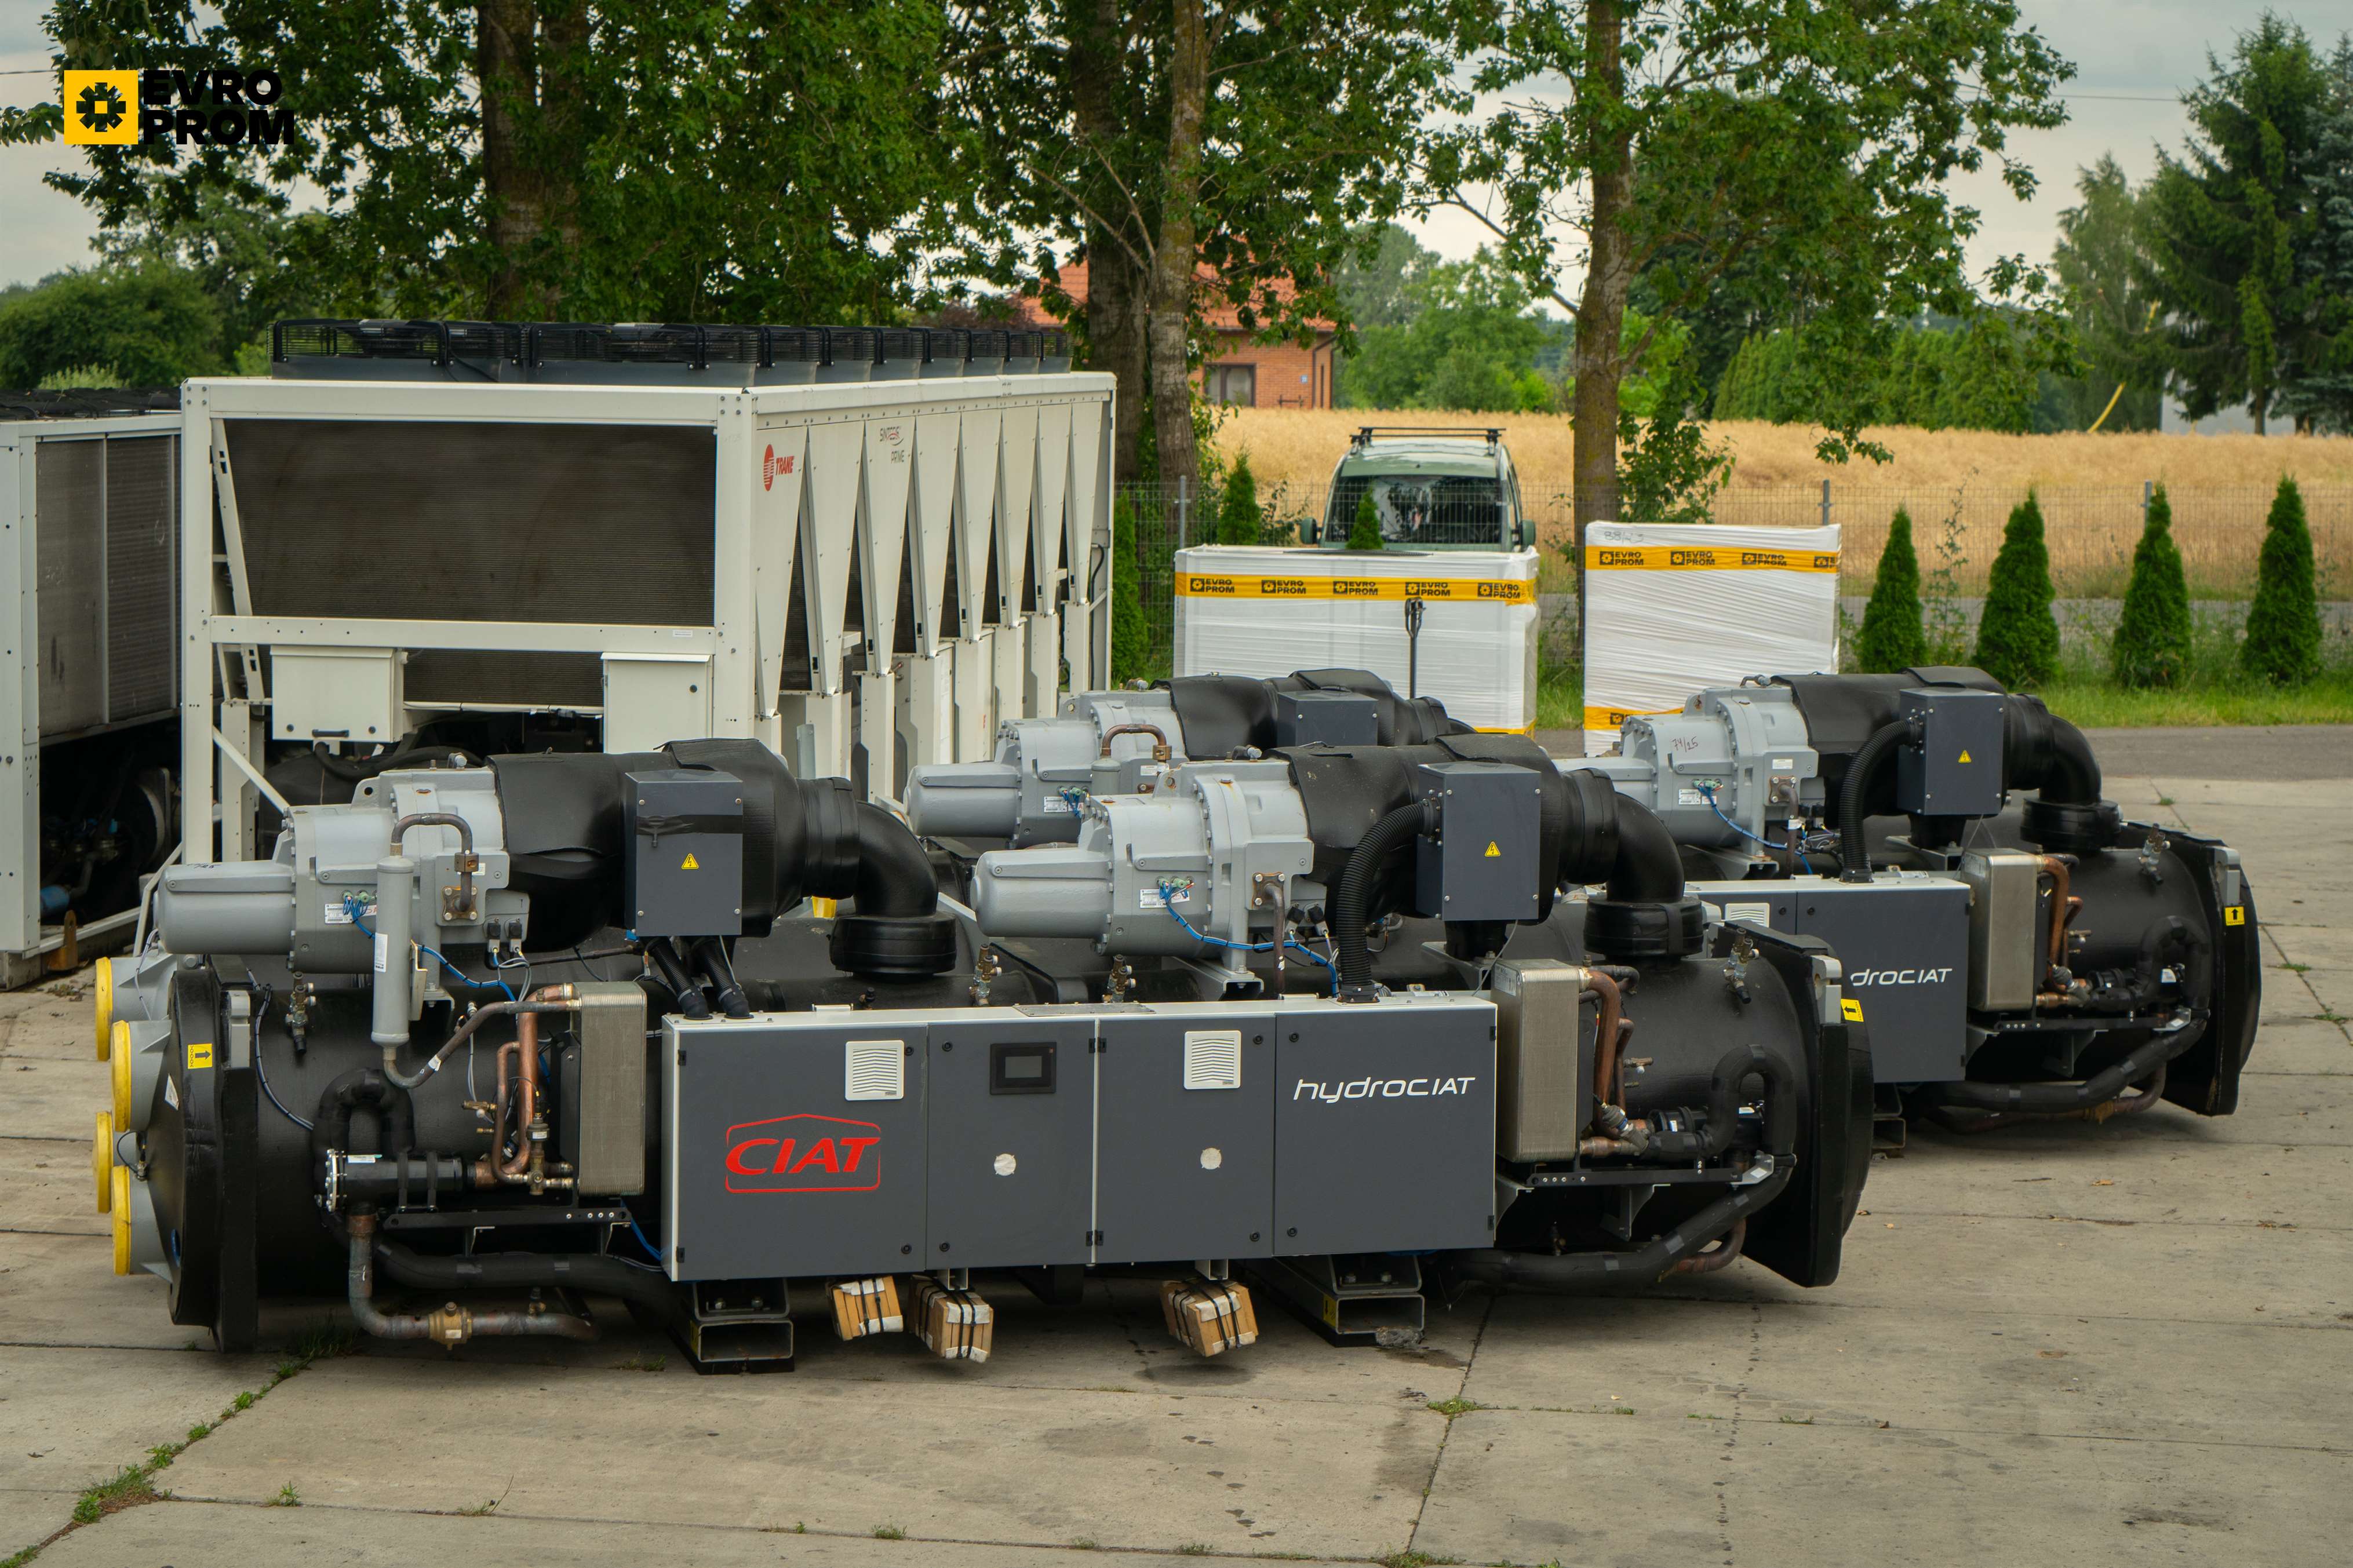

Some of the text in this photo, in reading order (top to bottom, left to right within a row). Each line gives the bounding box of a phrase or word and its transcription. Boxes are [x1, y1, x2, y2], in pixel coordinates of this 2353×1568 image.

[775, 455, 795, 475] TRANE
[1494, 591, 1521, 599] PROM
[726, 1137, 881, 1175] CIAT
